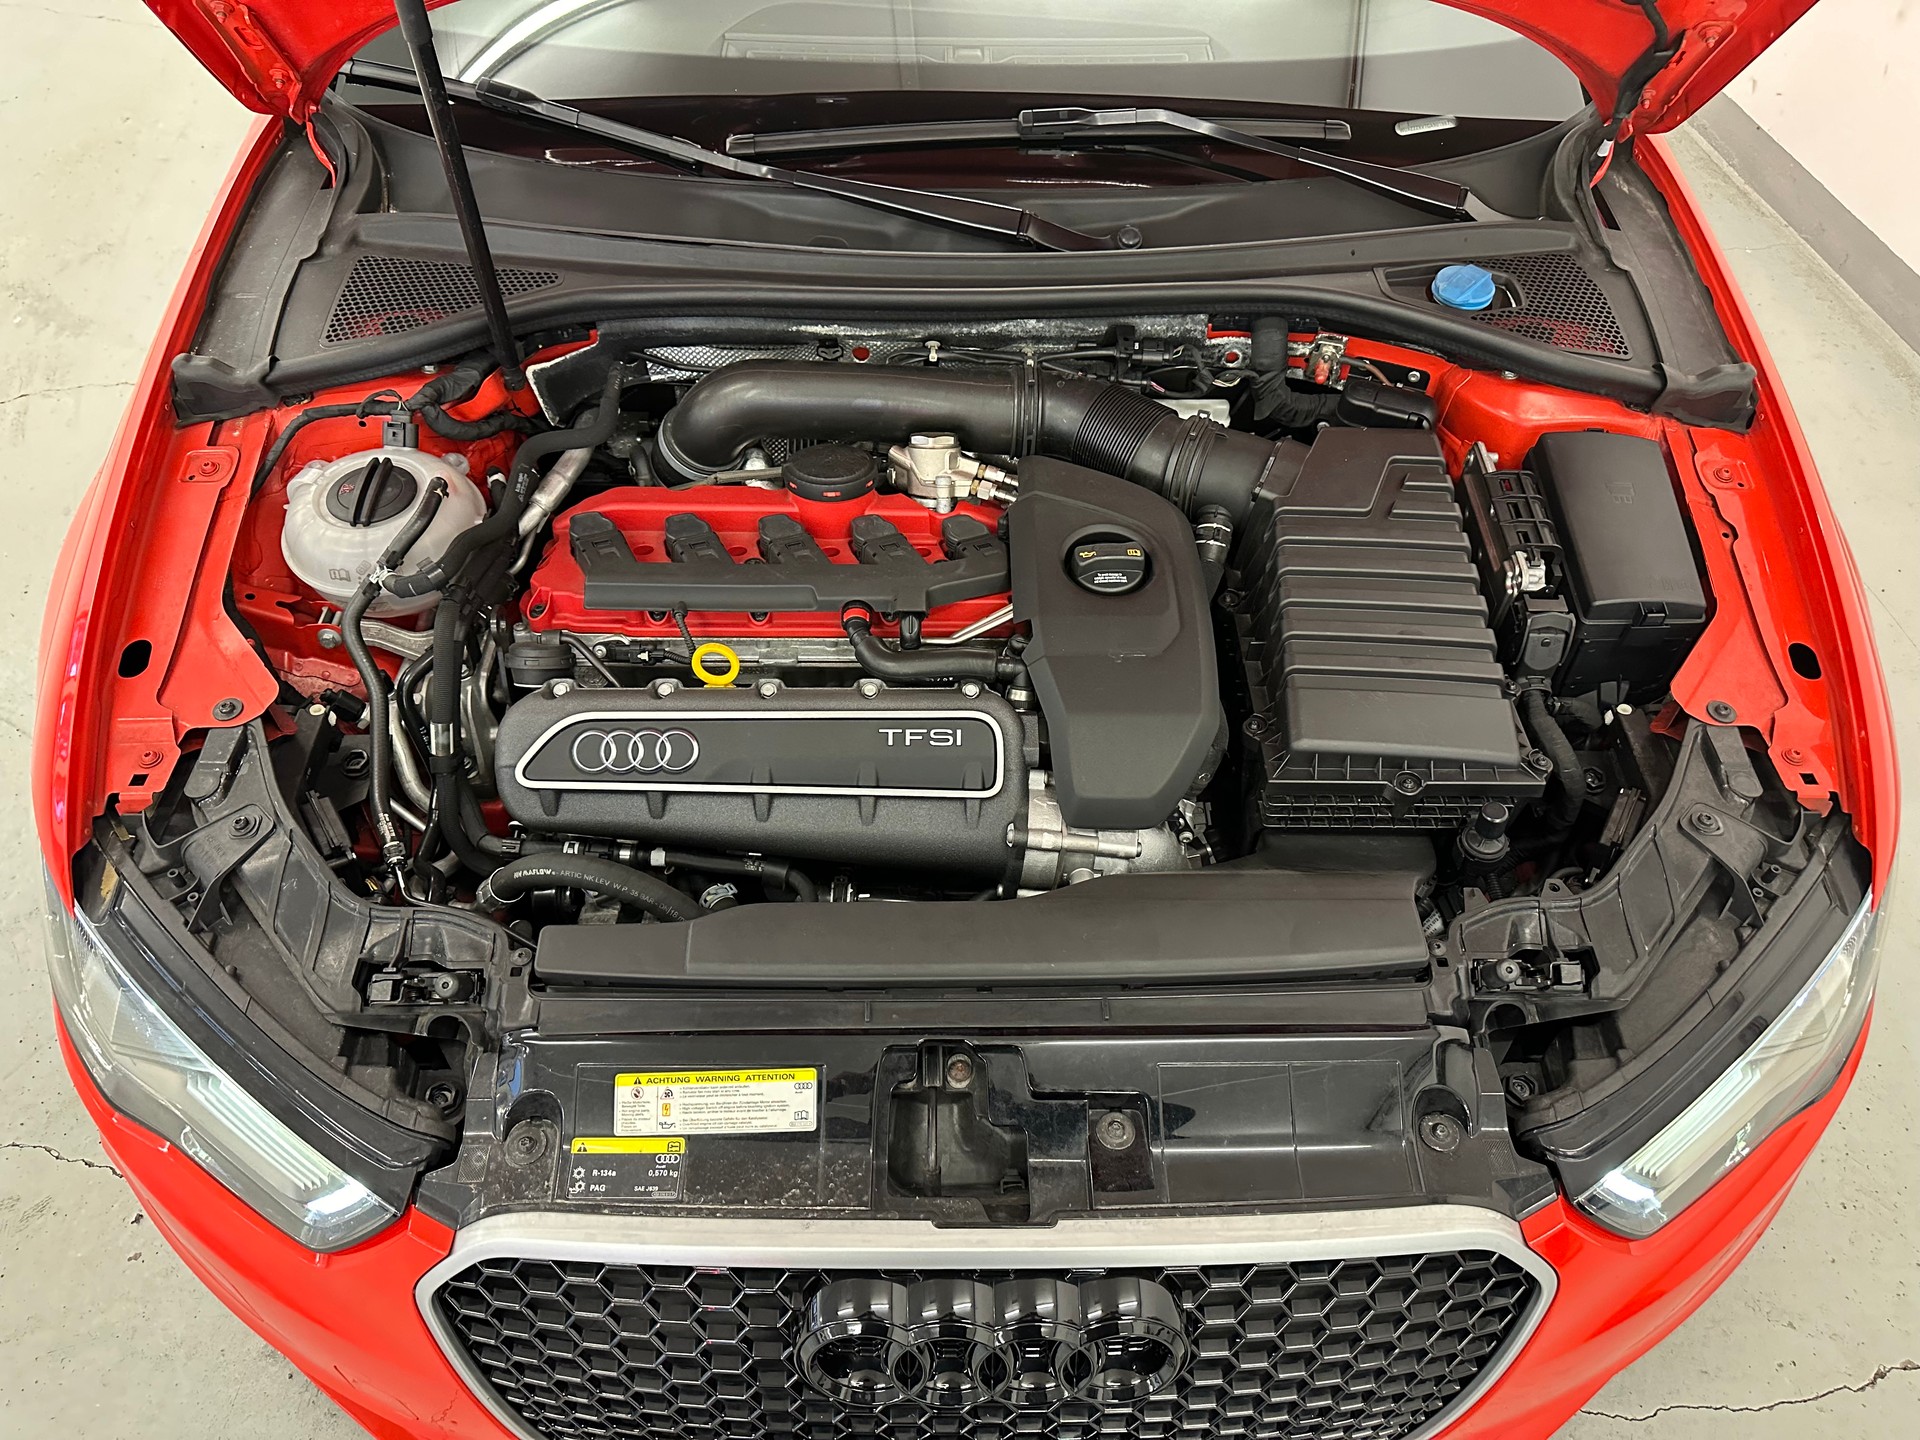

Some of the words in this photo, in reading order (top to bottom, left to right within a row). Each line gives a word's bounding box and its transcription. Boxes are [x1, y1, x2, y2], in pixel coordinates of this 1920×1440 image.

[878, 729, 962, 746] TFSI
[560, 870, 582, 879] ARTIC
[584, 873, 595, 882] NK
[595, 877, 610, 886] LEV
[630, 889, 639, 897] 35
[640, 893, 655, 905] BAR
[646, 1076, 691, 1085] ACHTUNG
[695, 1074, 741, 1083] WARNING
[745, 1073, 795, 1082] ATTENTION
[592, 1169, 617, 1177] R-134a
[669, 1169, 679, 1178] kg
[589, 1184, 606, 1192] PAG
